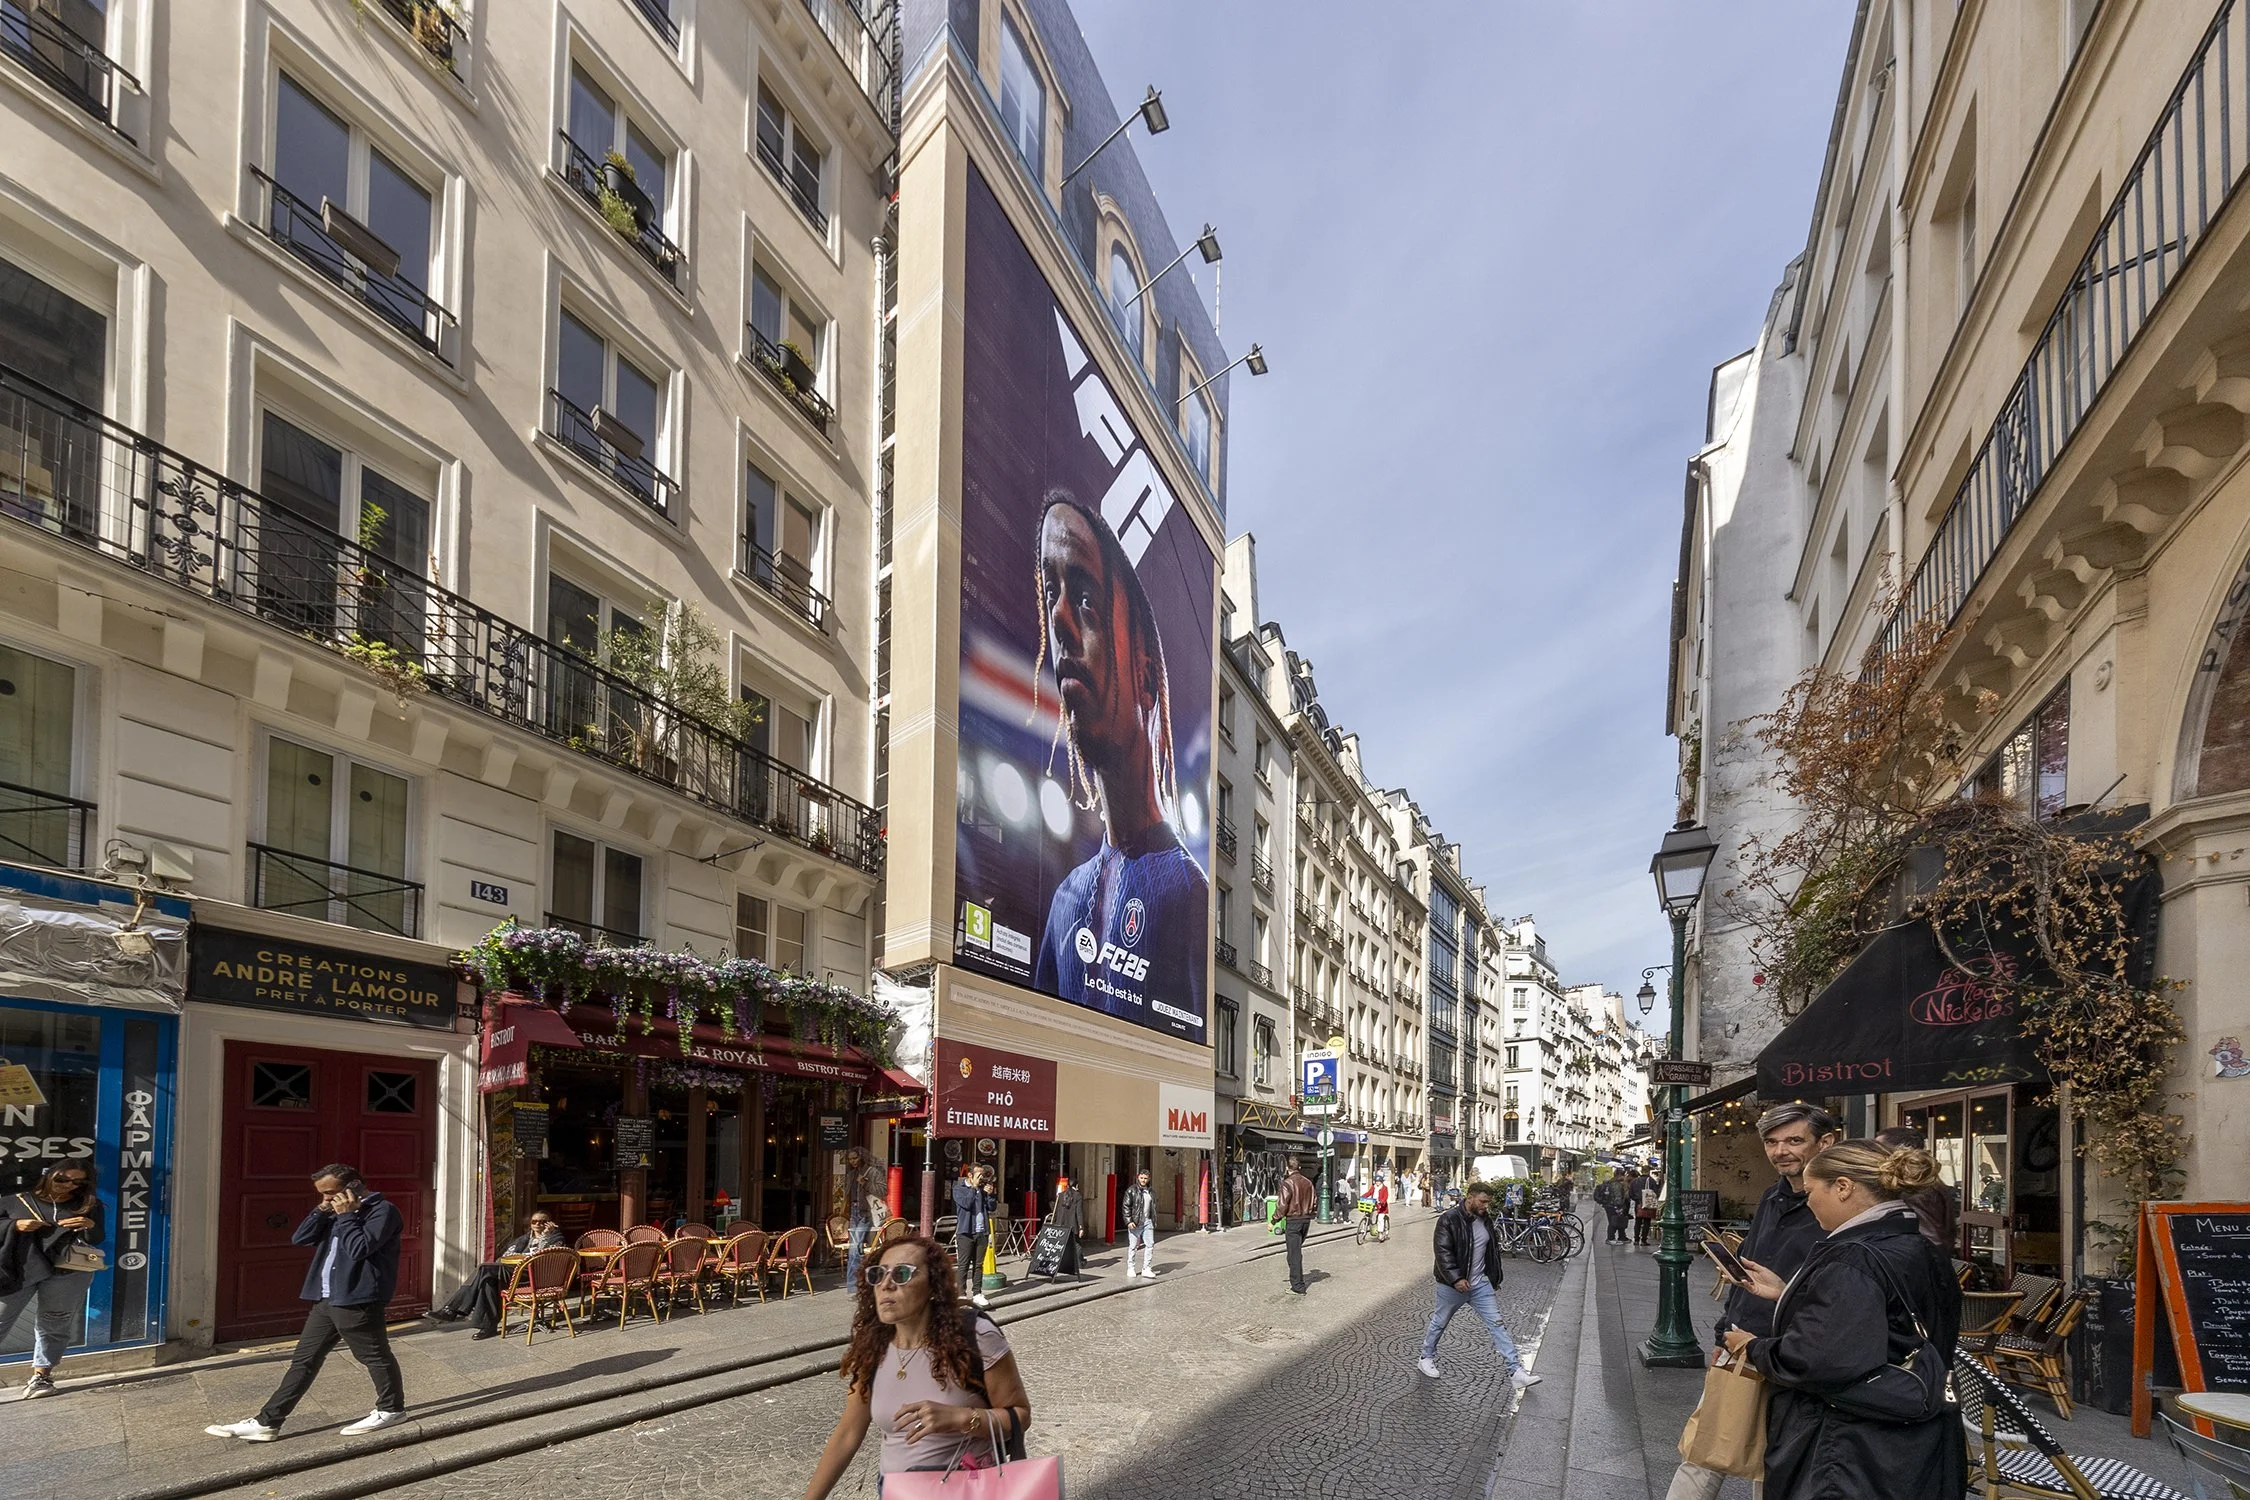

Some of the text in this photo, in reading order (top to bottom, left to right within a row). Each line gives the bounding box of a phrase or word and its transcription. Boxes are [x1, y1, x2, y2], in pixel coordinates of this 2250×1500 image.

[474, 882, 505, 903] 143
[972, 910, 984, 935] 3
[1078, 945, 1094, 956] SPORTS
[1079, 934, 1094, 950] EA
[256, 950, 408, 984] CRÉATIONS
[1936, 967, 1961, 988] Les
[212, 961, 439, 1007] ANDRÉ LAMOUR
[1084, 973, 1143, 1006] Le Club est à toi
[335, 998, 407, 1016] PORTER
[1156, 1002, 1200, 1024] JOUEZ MAINTENANT
[490, 1025, 516, 1048] BISTROT
[688, 1046, 709, 1058] LE
[712, 1048, 769, 1067] ROYAL
[797, 1061, 840, 1076] BISTROT
[1307, 1050, 1333, 1058] INDIGO
[992, 1064, 1031, 1084] 越南米粉
[1307, 1062, 1324, 1085] P
[1669, 1073, 1690, 1081] GRAND
[1671, 1064, 1695, 1074] PASSAGE
[1781, 1057, 1894, 1087] Bistrot
[987, 1090, 1014, 1106] PHÔ
[946, 1107, 1049, 1131] ÉTIENNE MARCEL
[1168, 1108, 1207, 1133] NAMI
[1043, 1227, 1066, 1237] MENU
[2214, 1376, 2249, 1384] Service
